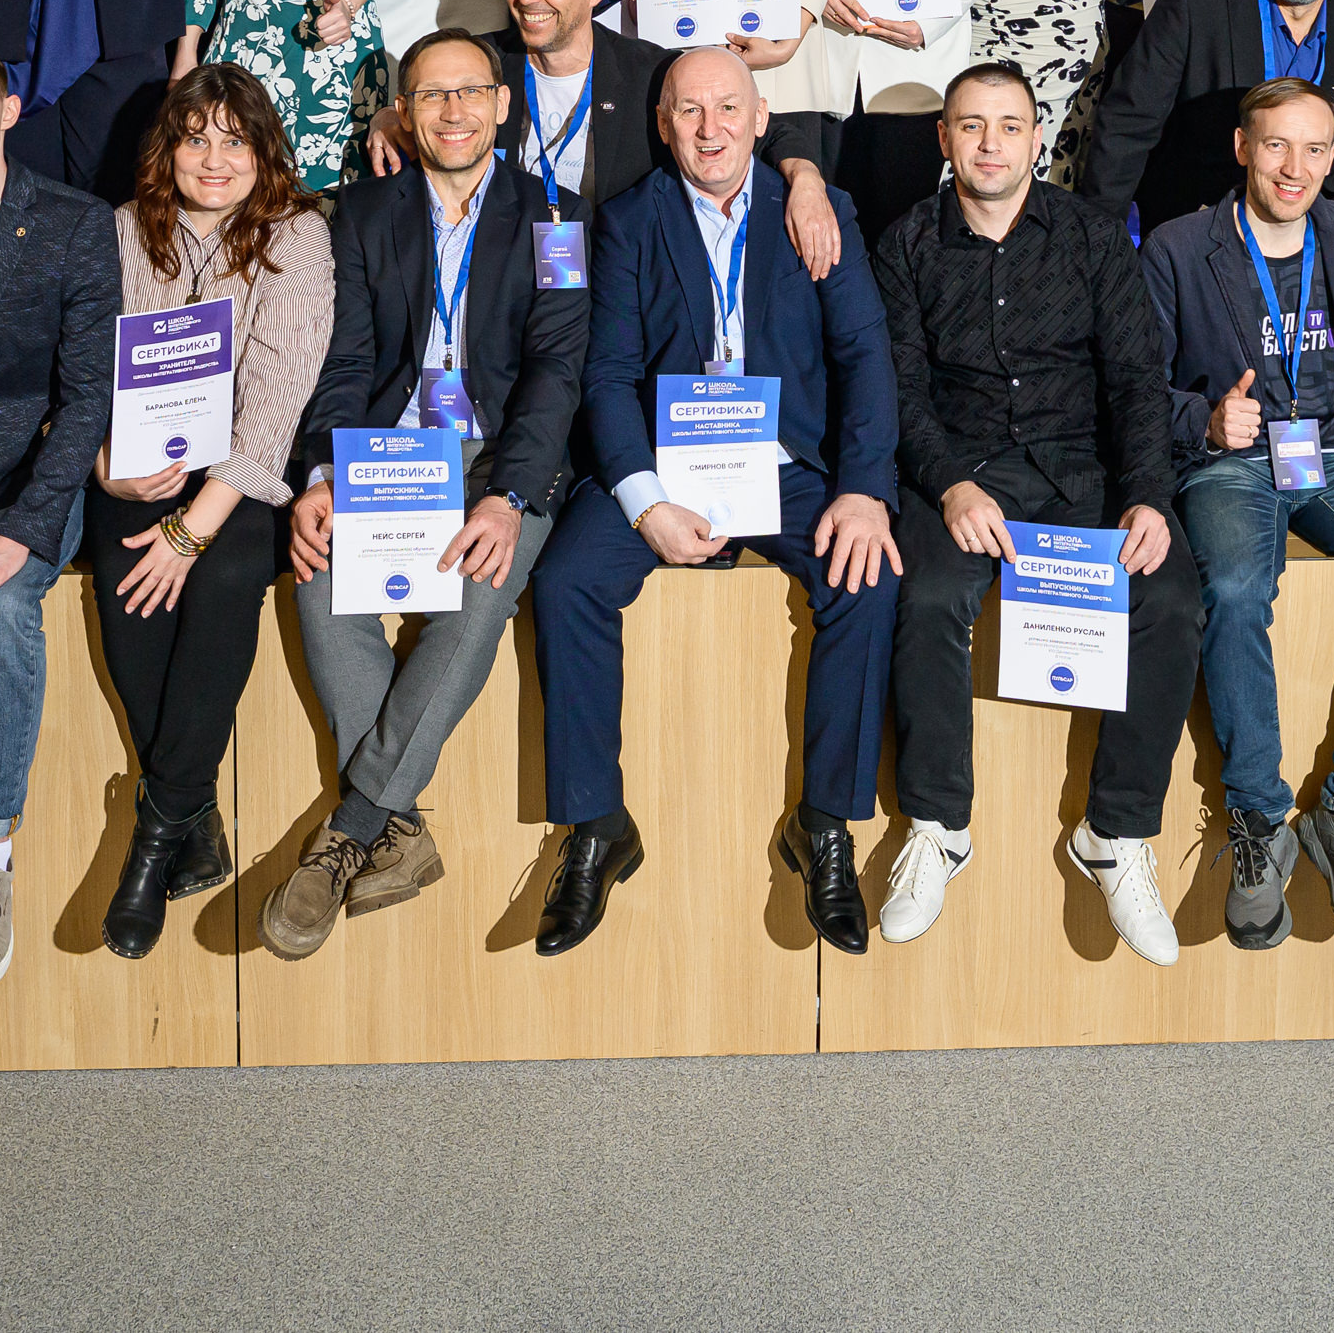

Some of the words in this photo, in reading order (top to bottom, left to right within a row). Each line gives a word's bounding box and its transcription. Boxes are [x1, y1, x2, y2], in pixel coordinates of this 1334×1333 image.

[1310, 313, 1323, 326] TV
[137, 337, 217, 359] СЕРТИФИКАТ
[158, 358, 196, 371] ХРАНИТЕЛЯ
[145, 400, 183, 411] БАРАНОВА
[185, 395, 207, 405] ЕЛЕНА
[676, 406, 760, 417] СЕРТИФИКАТ
[695, 421, 740, 429] НАСТАВНИКА
[354, 467, 443, 479] СЕРТИФИКАТ
[689, 463, 726, 471] СМИРНОВ
[374, 486, 425, 495] ВЫПУСКНИКА
[372, 531, 394, 540] НЕЙС
[396, 530, 425, 540] СЕРГЕЙ
[1053, 534, 1082, 543] ШКОЛА
[1021, 561, 1109, 580] СЕРТИФИКАТ
[1040, 581, 1089, 594] ВЫПУСКНИКА
[1023, 622, 1072, 634] ДАНИЛЕНКО
[1073, 627, 1105, 637] РУСЛАН
